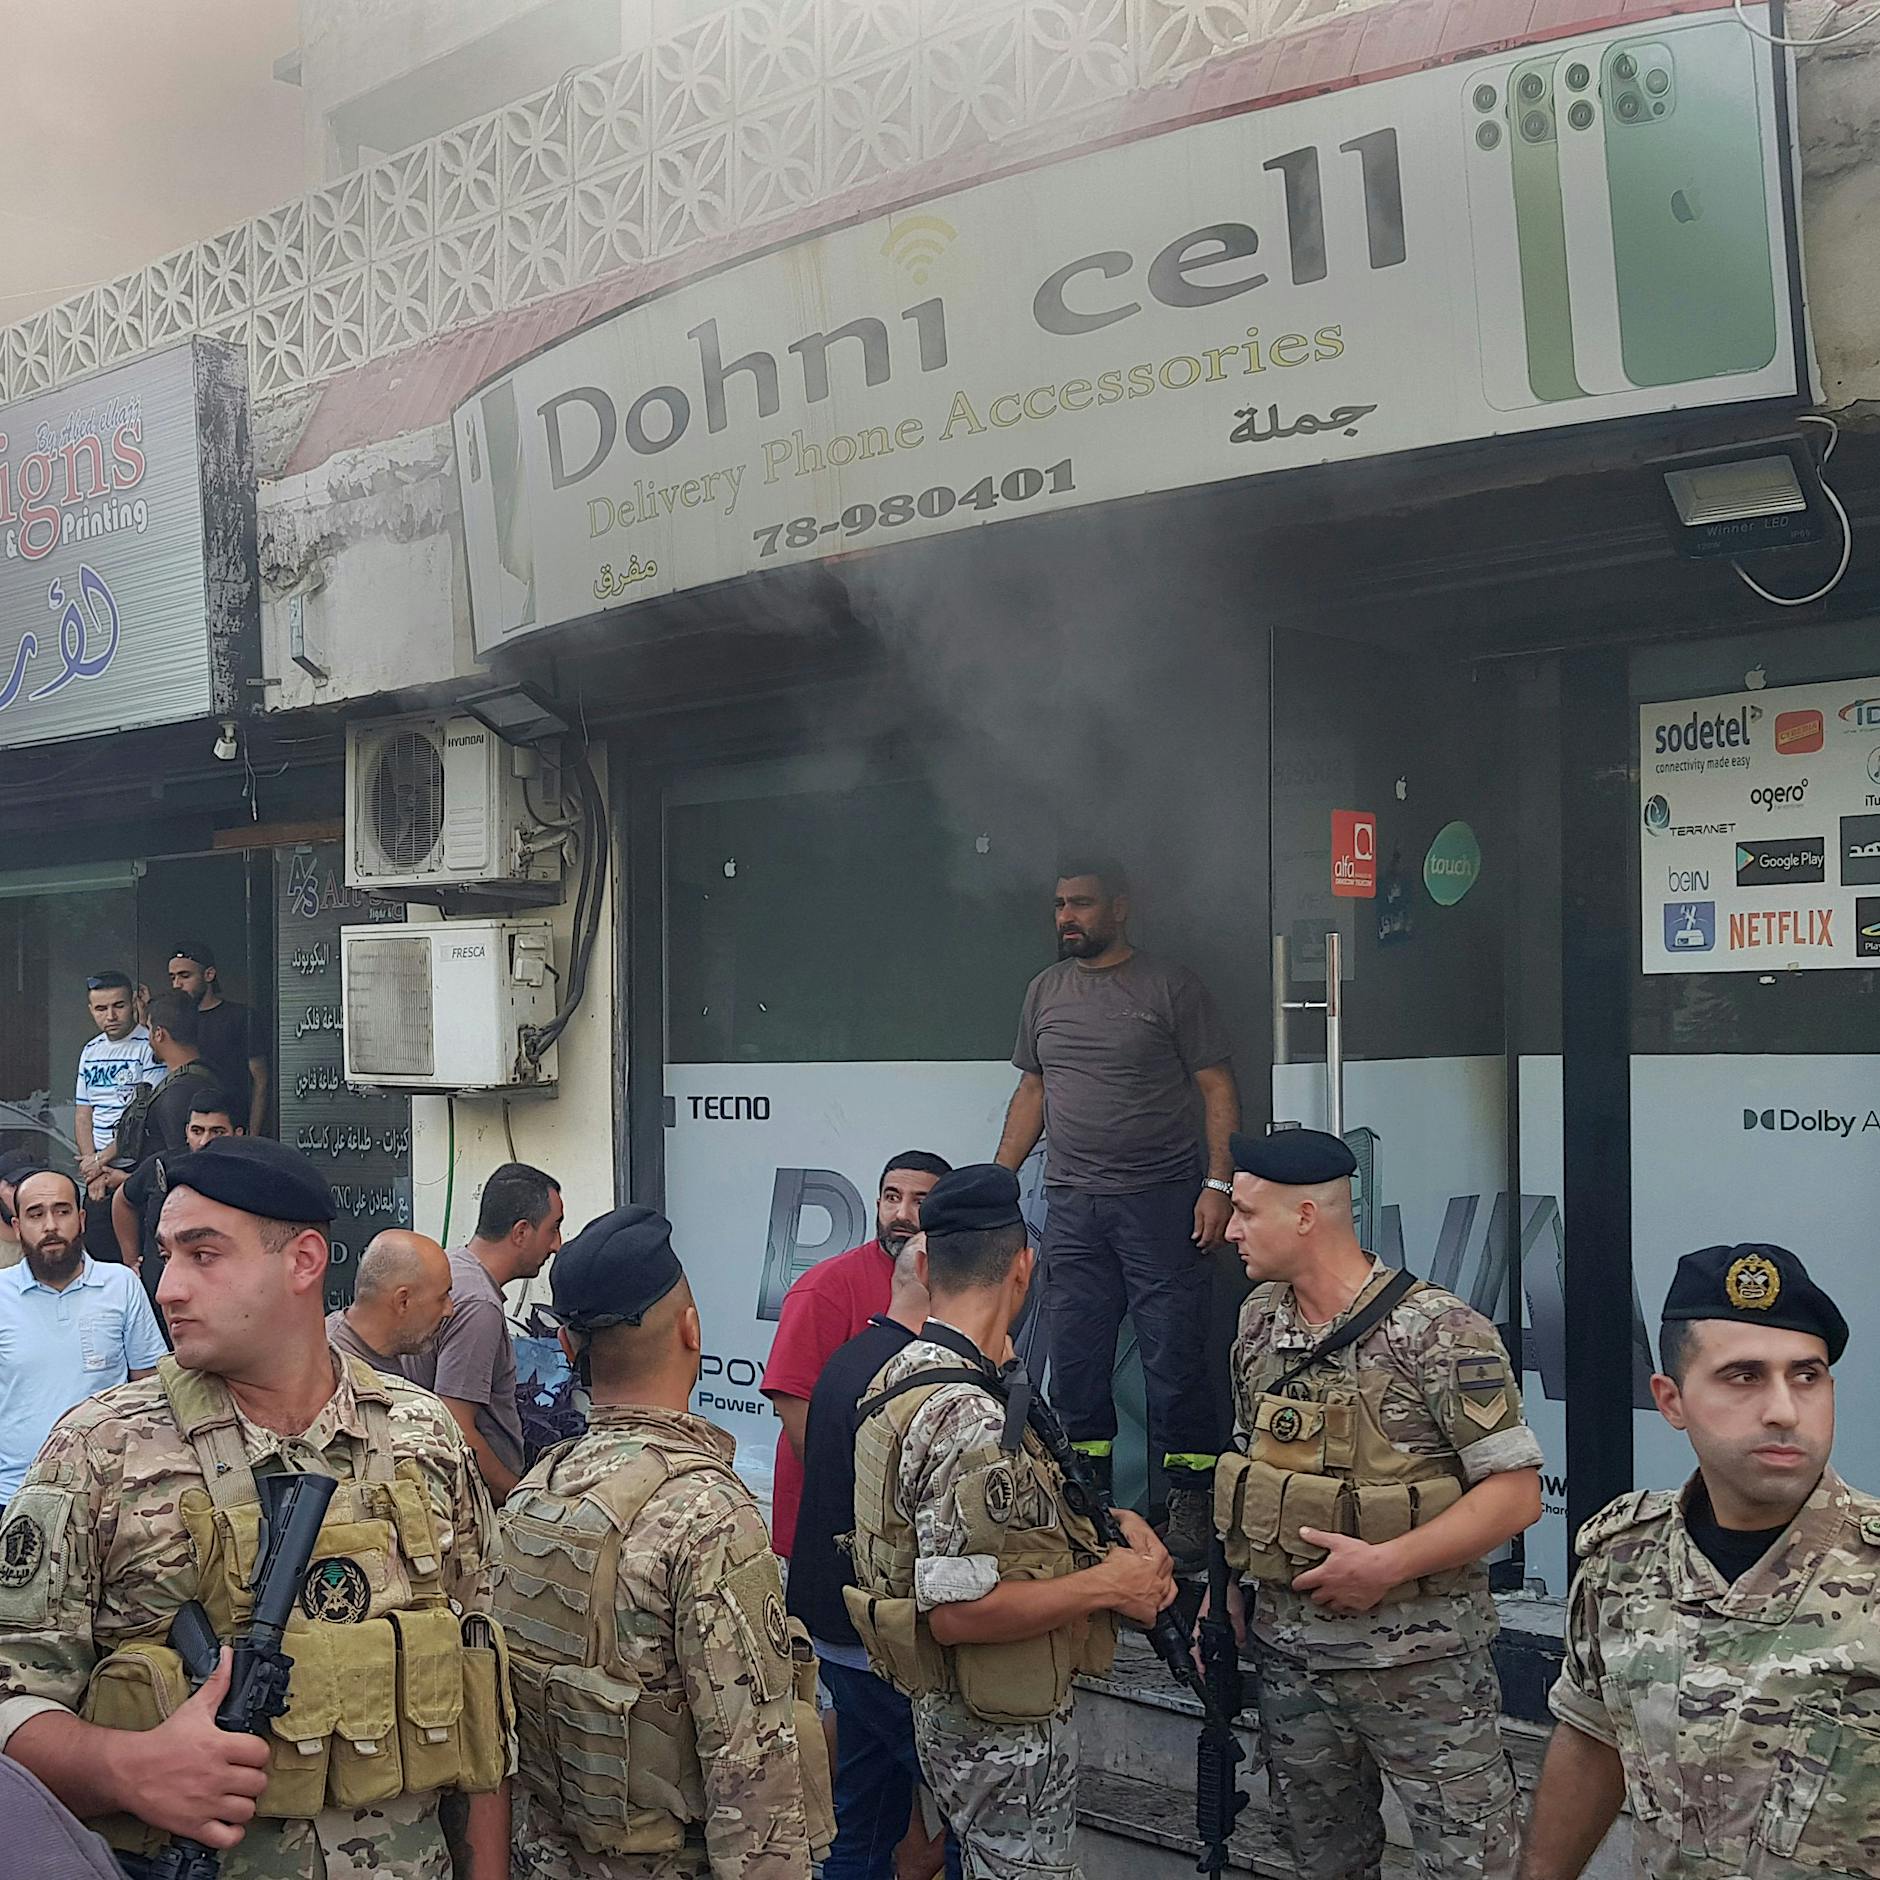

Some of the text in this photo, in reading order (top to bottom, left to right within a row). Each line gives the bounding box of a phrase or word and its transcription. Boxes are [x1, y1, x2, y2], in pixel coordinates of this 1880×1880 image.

[536, 127, 1407, 491] Dohni cell
[586, 323, 1346, 539] Delivery Phone Accessories
[1229, 402, 1379, 445] جملة
[61, 497, 150, 546] Printing
[752, 458, 1077, 558] 78-980401
[592, 553, 659, 599] مفرق
[447, 733, 485, 749] HYUNDAI
[1655, 705, 1751, 754] sodetel
[1655, 755, 1751, 775] connectivity made easy
[1669, 822, 1737, 837] TERRANET
[1335, 855, 1355, 878] alfa
[1430, 853, 1473, 877] touch
[1759, 851, 1824, 870] Google Play
[1729, 908, 1833, 951] NETFLIX
[451, 946, 486, 961] FRESCA
[686, 1095, 771, 1121] TECNO
[1780, 1109, 1857, 1138] Dolby
[330, 1126, 346, 1158] على
[346, 1126, 372, 1159] طباعة
[698, 1391, 765, 1415] Power
